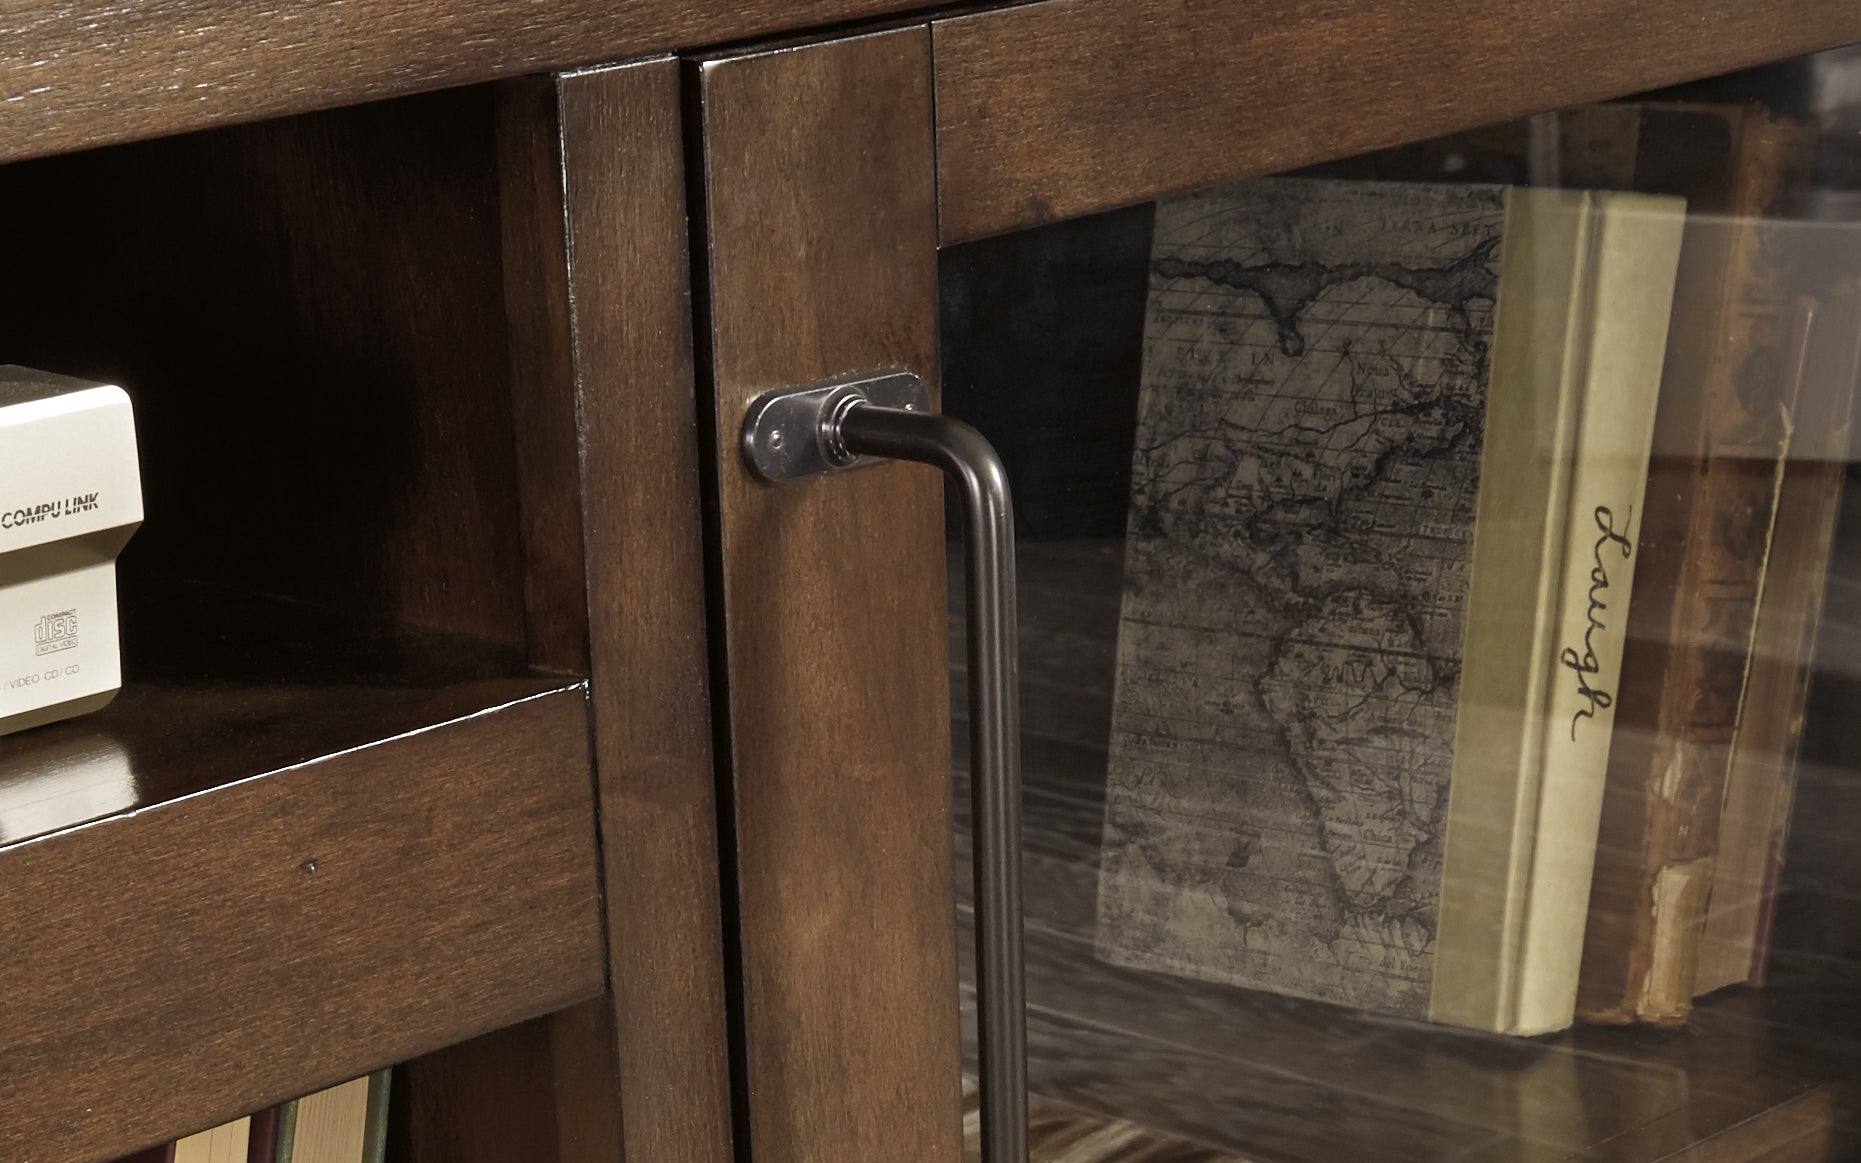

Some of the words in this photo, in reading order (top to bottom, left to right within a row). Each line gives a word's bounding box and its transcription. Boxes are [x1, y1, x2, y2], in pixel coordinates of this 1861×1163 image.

[1, 500, 61, 529] COMPU
[65, 491, 99, 516] LINK
[34, 615, 78, 643] disc
[1561, 504, 1632, 742] Laugh
